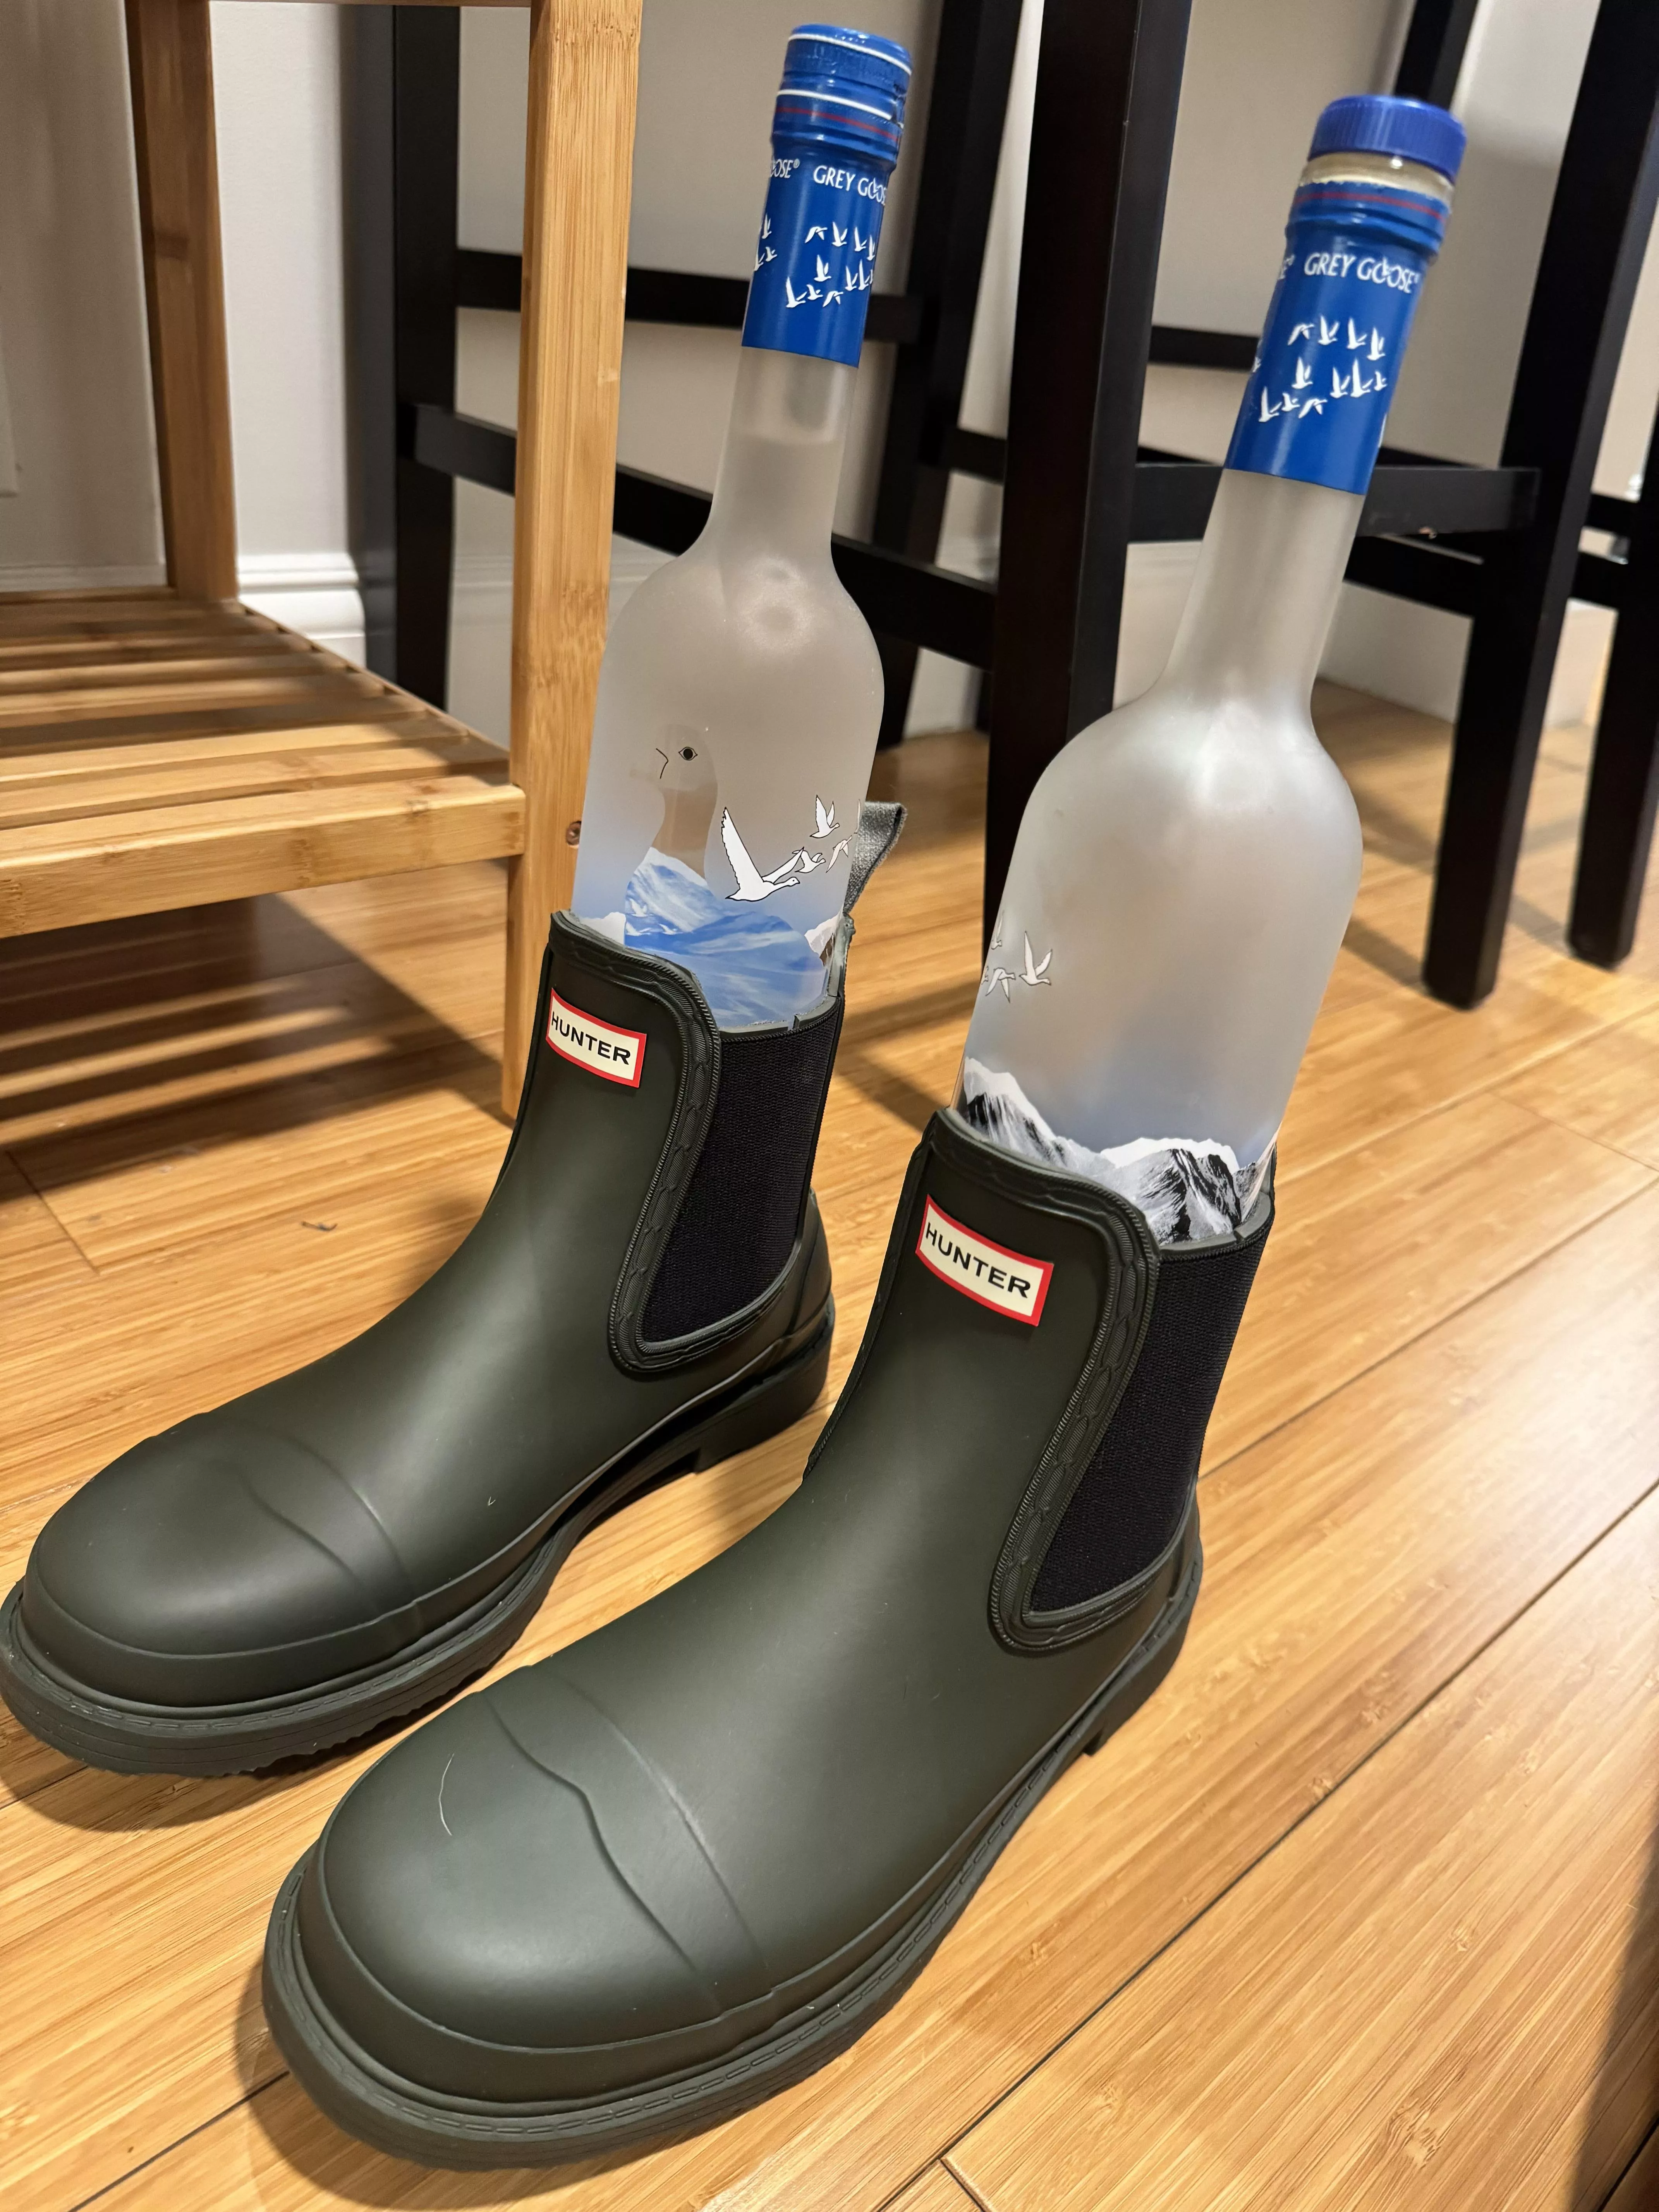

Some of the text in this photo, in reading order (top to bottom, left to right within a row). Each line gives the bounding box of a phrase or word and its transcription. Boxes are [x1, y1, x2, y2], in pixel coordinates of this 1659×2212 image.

[813, 165, 887, 206] GREY GOOS
[1304, 253, 1357, 278] GREY
[551, 1011, 631, 1065] HUNTER
[925, 1222, 1031, 1298] HUNTER
